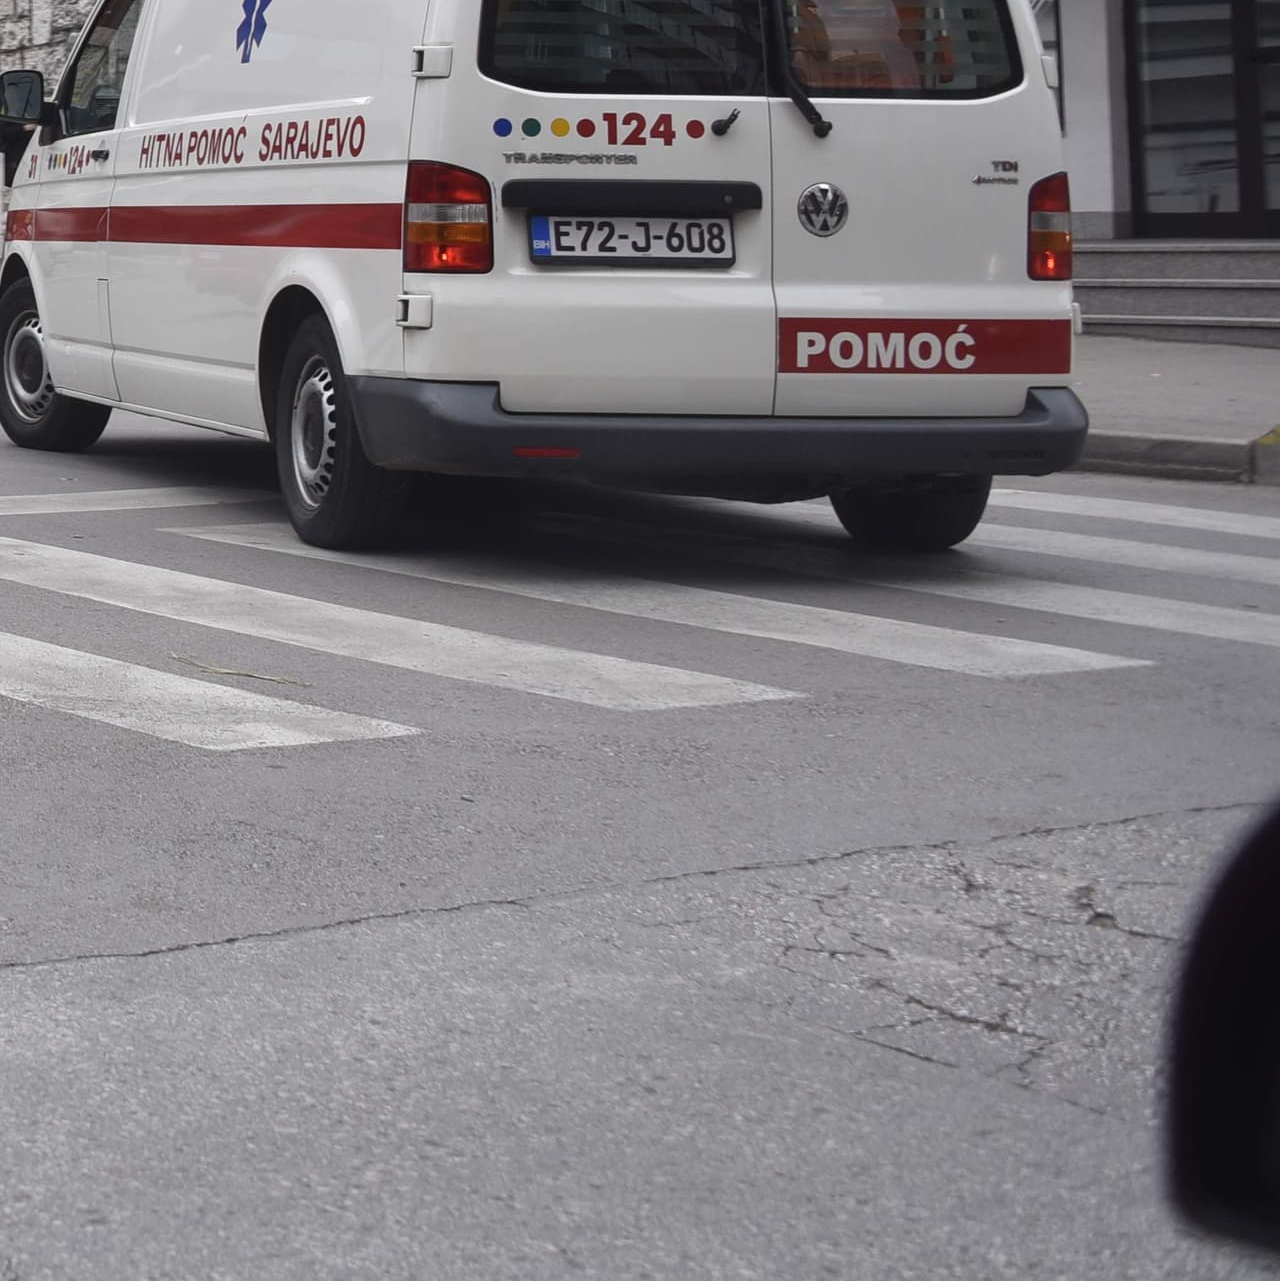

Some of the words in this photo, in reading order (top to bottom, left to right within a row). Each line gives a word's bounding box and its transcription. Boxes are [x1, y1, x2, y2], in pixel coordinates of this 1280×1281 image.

[139, 131, 184, 168] HITNA
[186, 114, 249, 166] POMOĆ
[258, 114, 366, 161] SARAJEVO
[602, 112, 676, 146] 124
[68, 145, 85, 174] 124
[502, 153, 638, 165] TRANSPORTER
[533, 240, 550, 249] BIH
[554, 220, 726, 254] E72-J-608
[796, 324, 976, 370] POMOĆ
